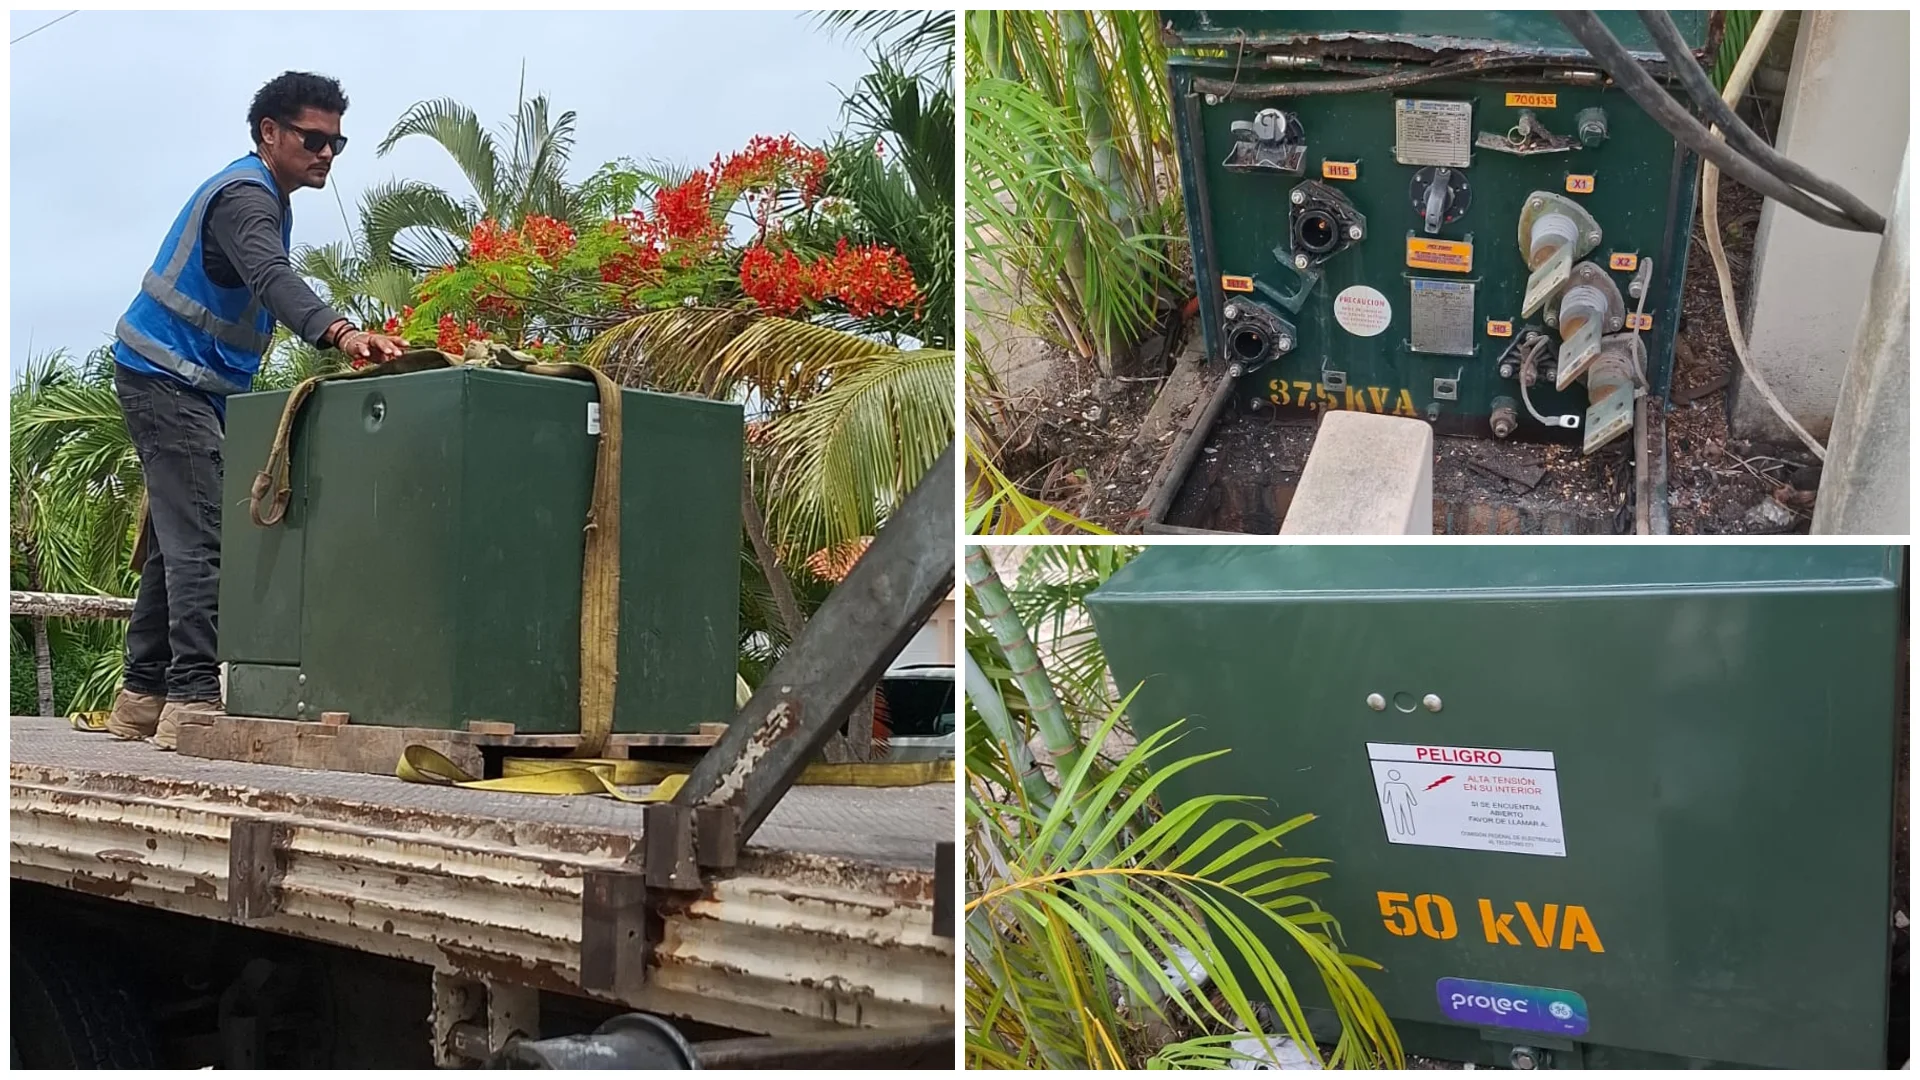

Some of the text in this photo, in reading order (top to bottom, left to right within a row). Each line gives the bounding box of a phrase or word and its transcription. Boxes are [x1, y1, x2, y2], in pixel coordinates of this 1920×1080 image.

[1514, 94, 1555, 106] 700135
[1328, 166, 1350, 176] H1B
[1573, 179, 1587, 189] X1
[1616, 257, 1630, 267] X2
[1416, 747, 1502, 765] PELIGRO
[1467, 775, 1536, 786] ALTA TENSIÓN
[1463, 783, 1477, 791] EN
[1495, 786, 1542, 795] INTERIOR
[1492, 802, 1541, 811] ENCUENTRA
[1490, 810, 1524, 818] ABIERTO
[1468, 816, 1494, 824] FAVOR
[1508, 819, 1538, 827] LLAMAR
[1376, 891, 1605, 953] 50 kVA
[1451, 993, 1528, 1015] prolec
